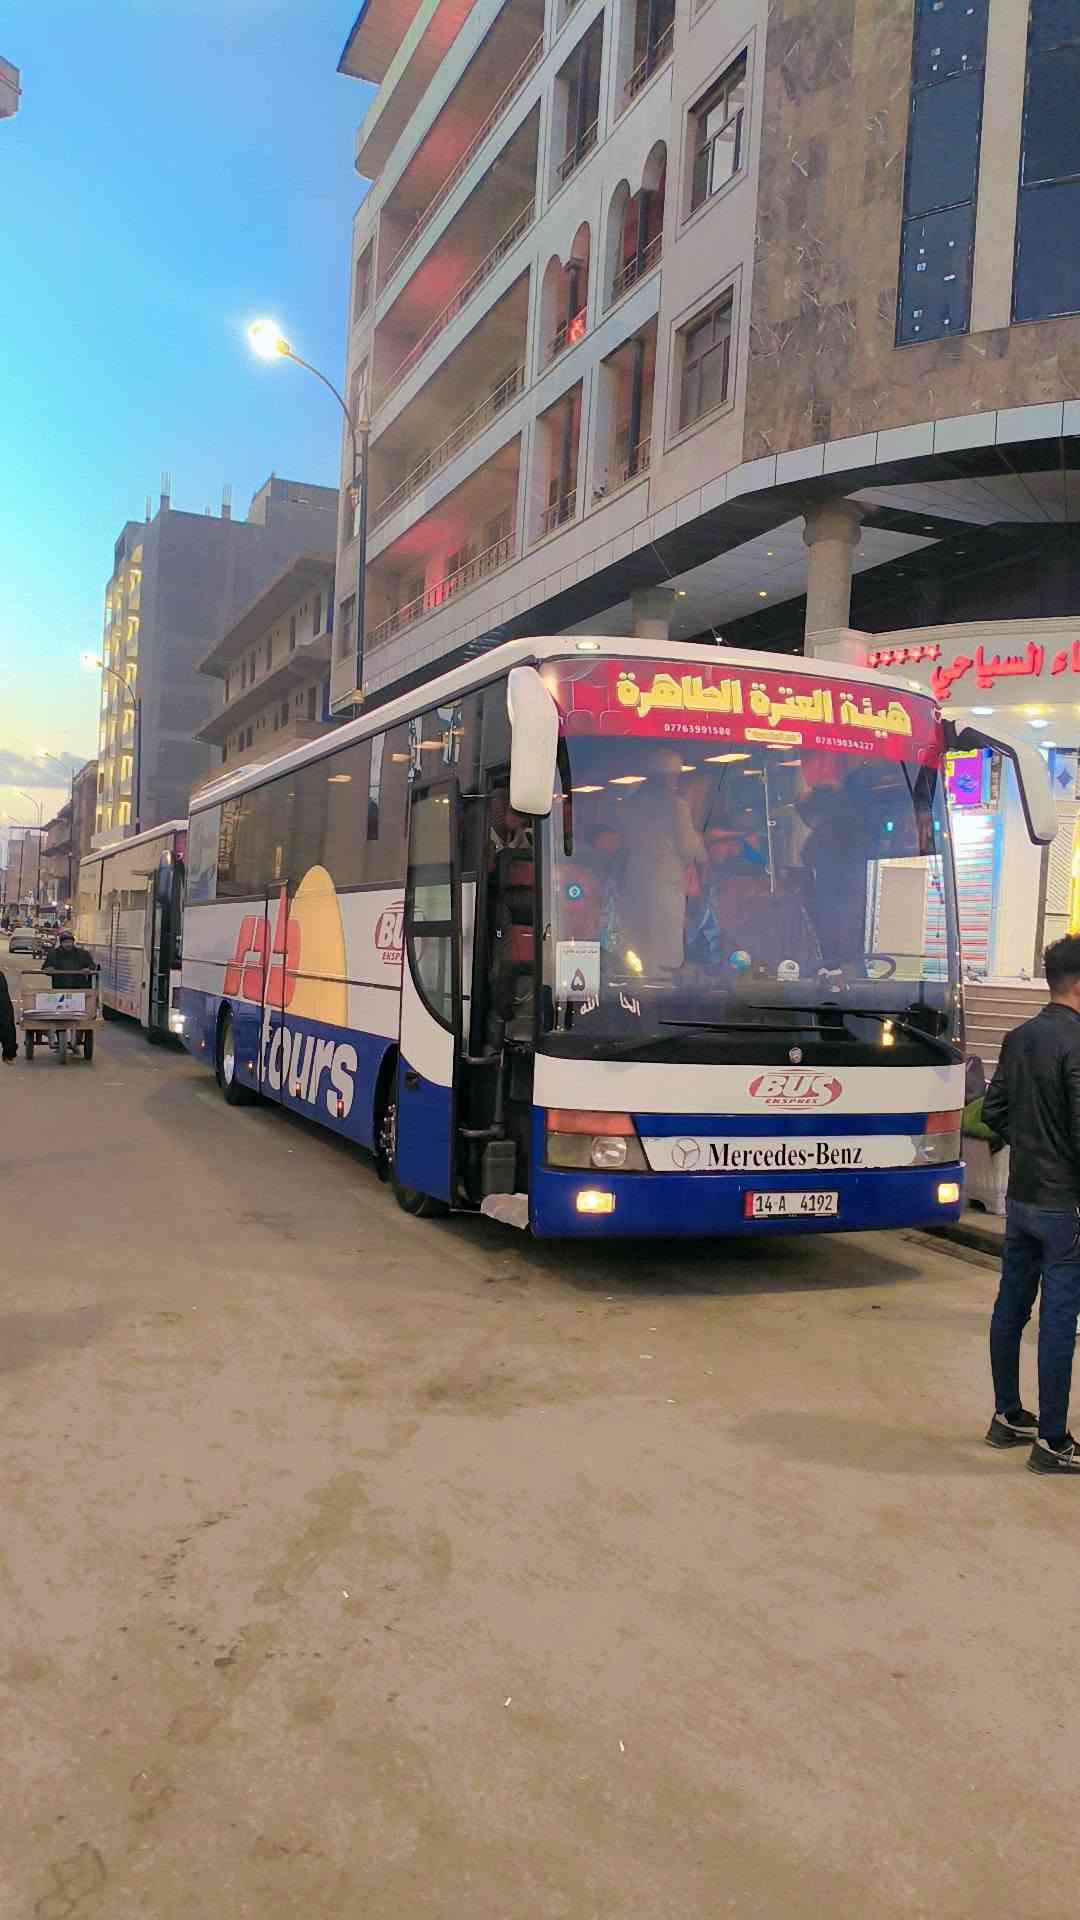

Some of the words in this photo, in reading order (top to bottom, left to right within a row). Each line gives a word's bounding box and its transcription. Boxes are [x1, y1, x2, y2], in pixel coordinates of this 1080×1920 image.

[930, 640, 1044, 699] السياحي
[616, 671, 743, 718] الطاهرة
[700, 681, 835, 727] العترة
[840, 692, 912, 739] هيئة
[257, 1007, 358, 1119] tours
[755, 1075, 833, 1105] BUS
[707, 1141, 864, 1167] Mercedes-Benz
[756, 1195, 773, 1212] 14
[778, 1195, 786, 1211] A
[800, 1194, 833, 1211] 4192
